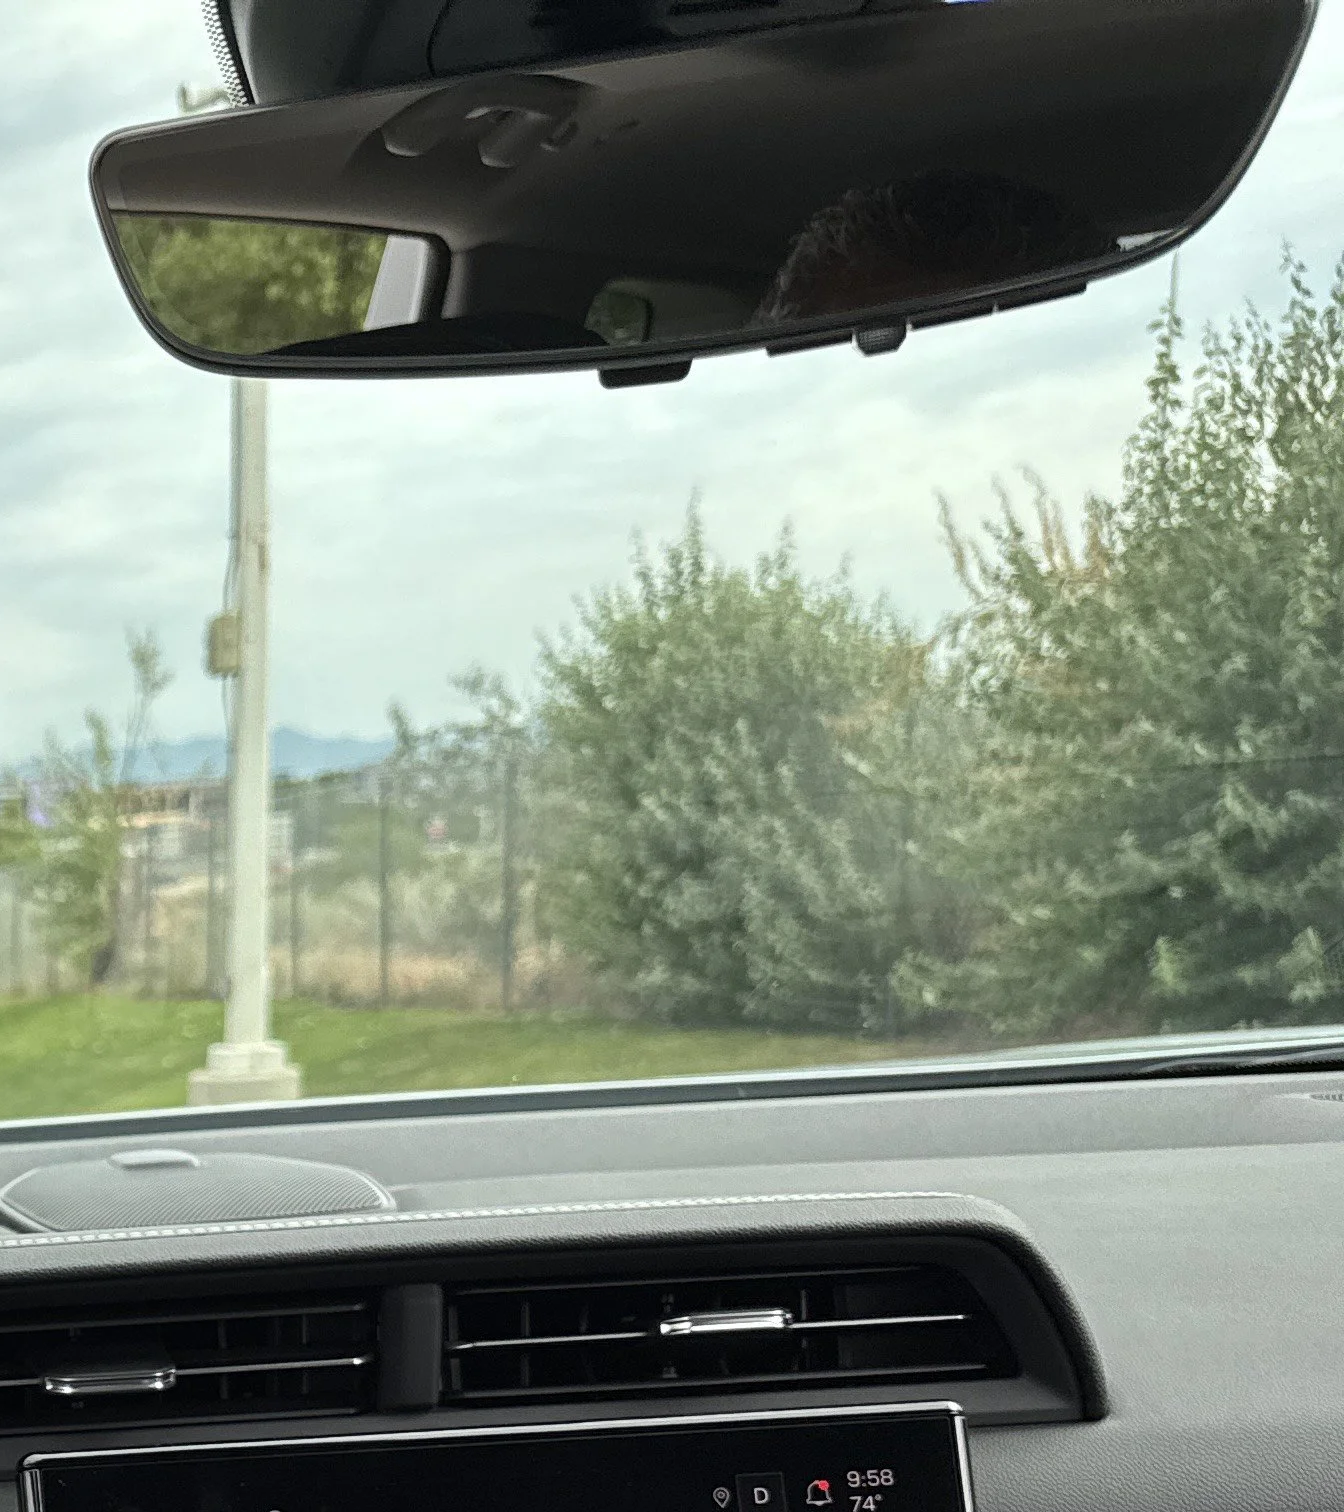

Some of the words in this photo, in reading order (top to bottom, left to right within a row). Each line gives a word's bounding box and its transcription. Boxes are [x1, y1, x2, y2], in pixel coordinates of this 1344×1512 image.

[847, 1469, 894, 1487] 9:58
[754, 1488, 768, 1504] D
[850, 1494, 881, 1512] 74°
